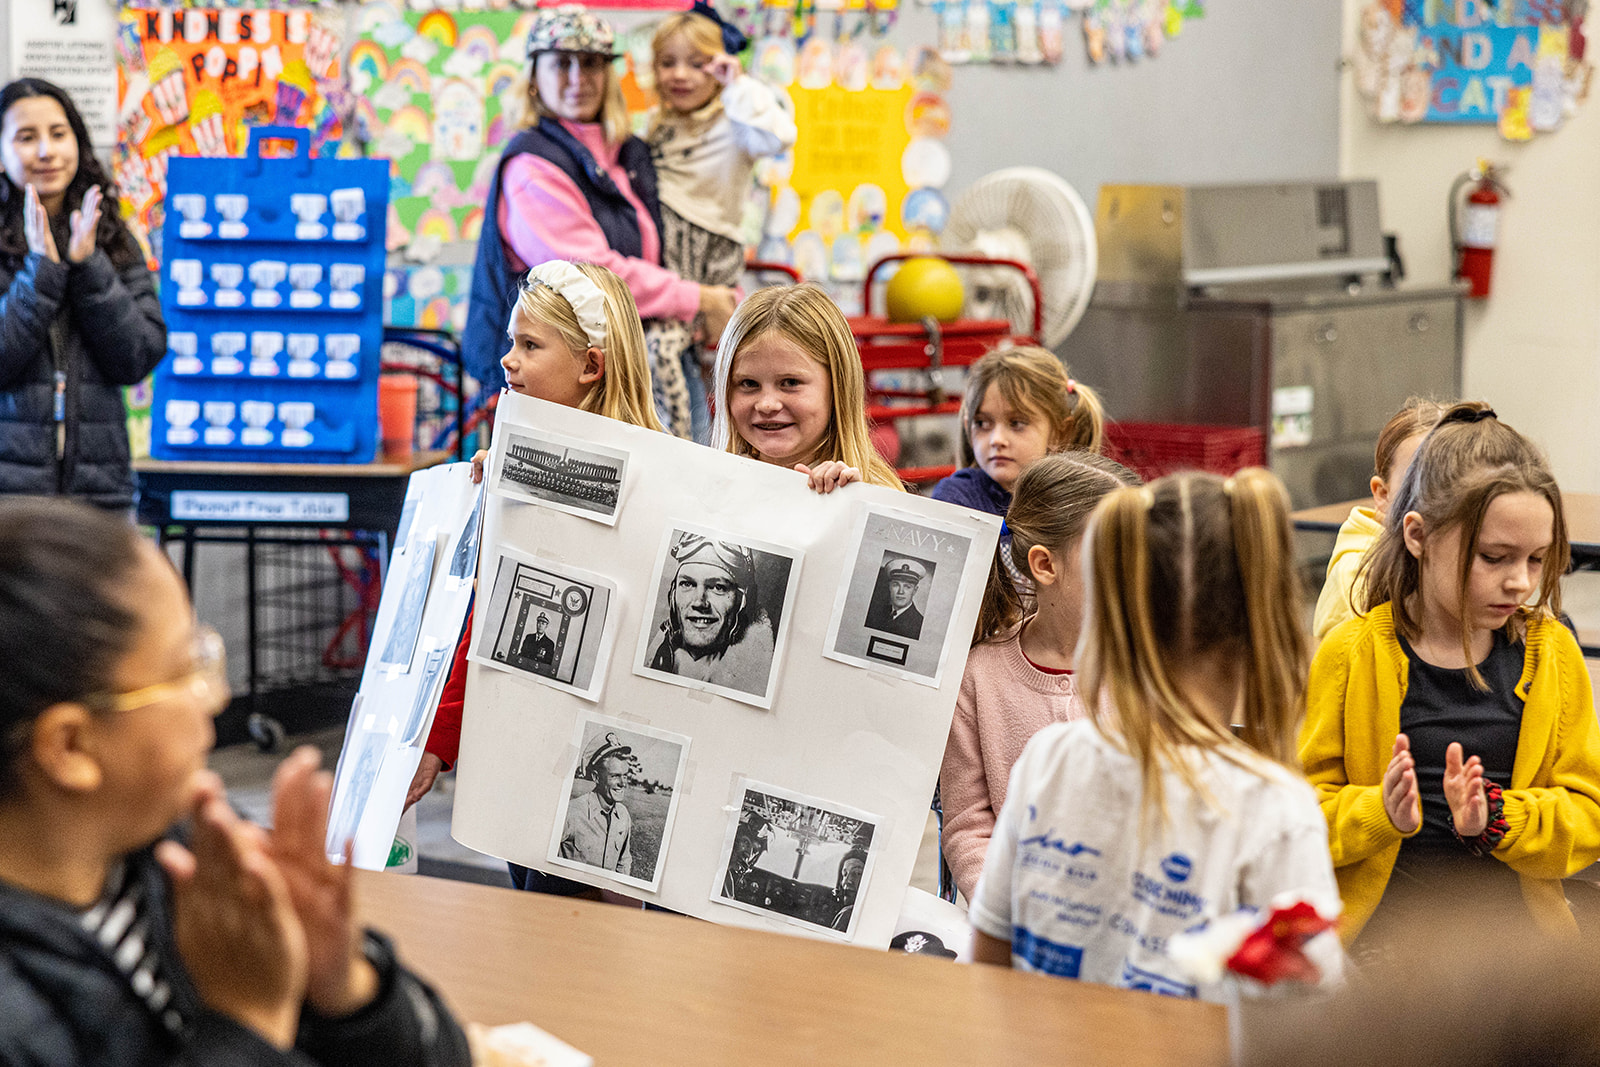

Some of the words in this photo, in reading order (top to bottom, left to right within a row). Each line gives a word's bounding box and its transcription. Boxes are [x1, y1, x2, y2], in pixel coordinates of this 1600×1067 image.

[146, 10, 271, 43] KINDNESS
[284, 11, 308, 43] IS
[1506, 34, 1539, 70] A
[1431, 76, 1513, 114] CAT
[886, 523, 947, 552] NAVY
